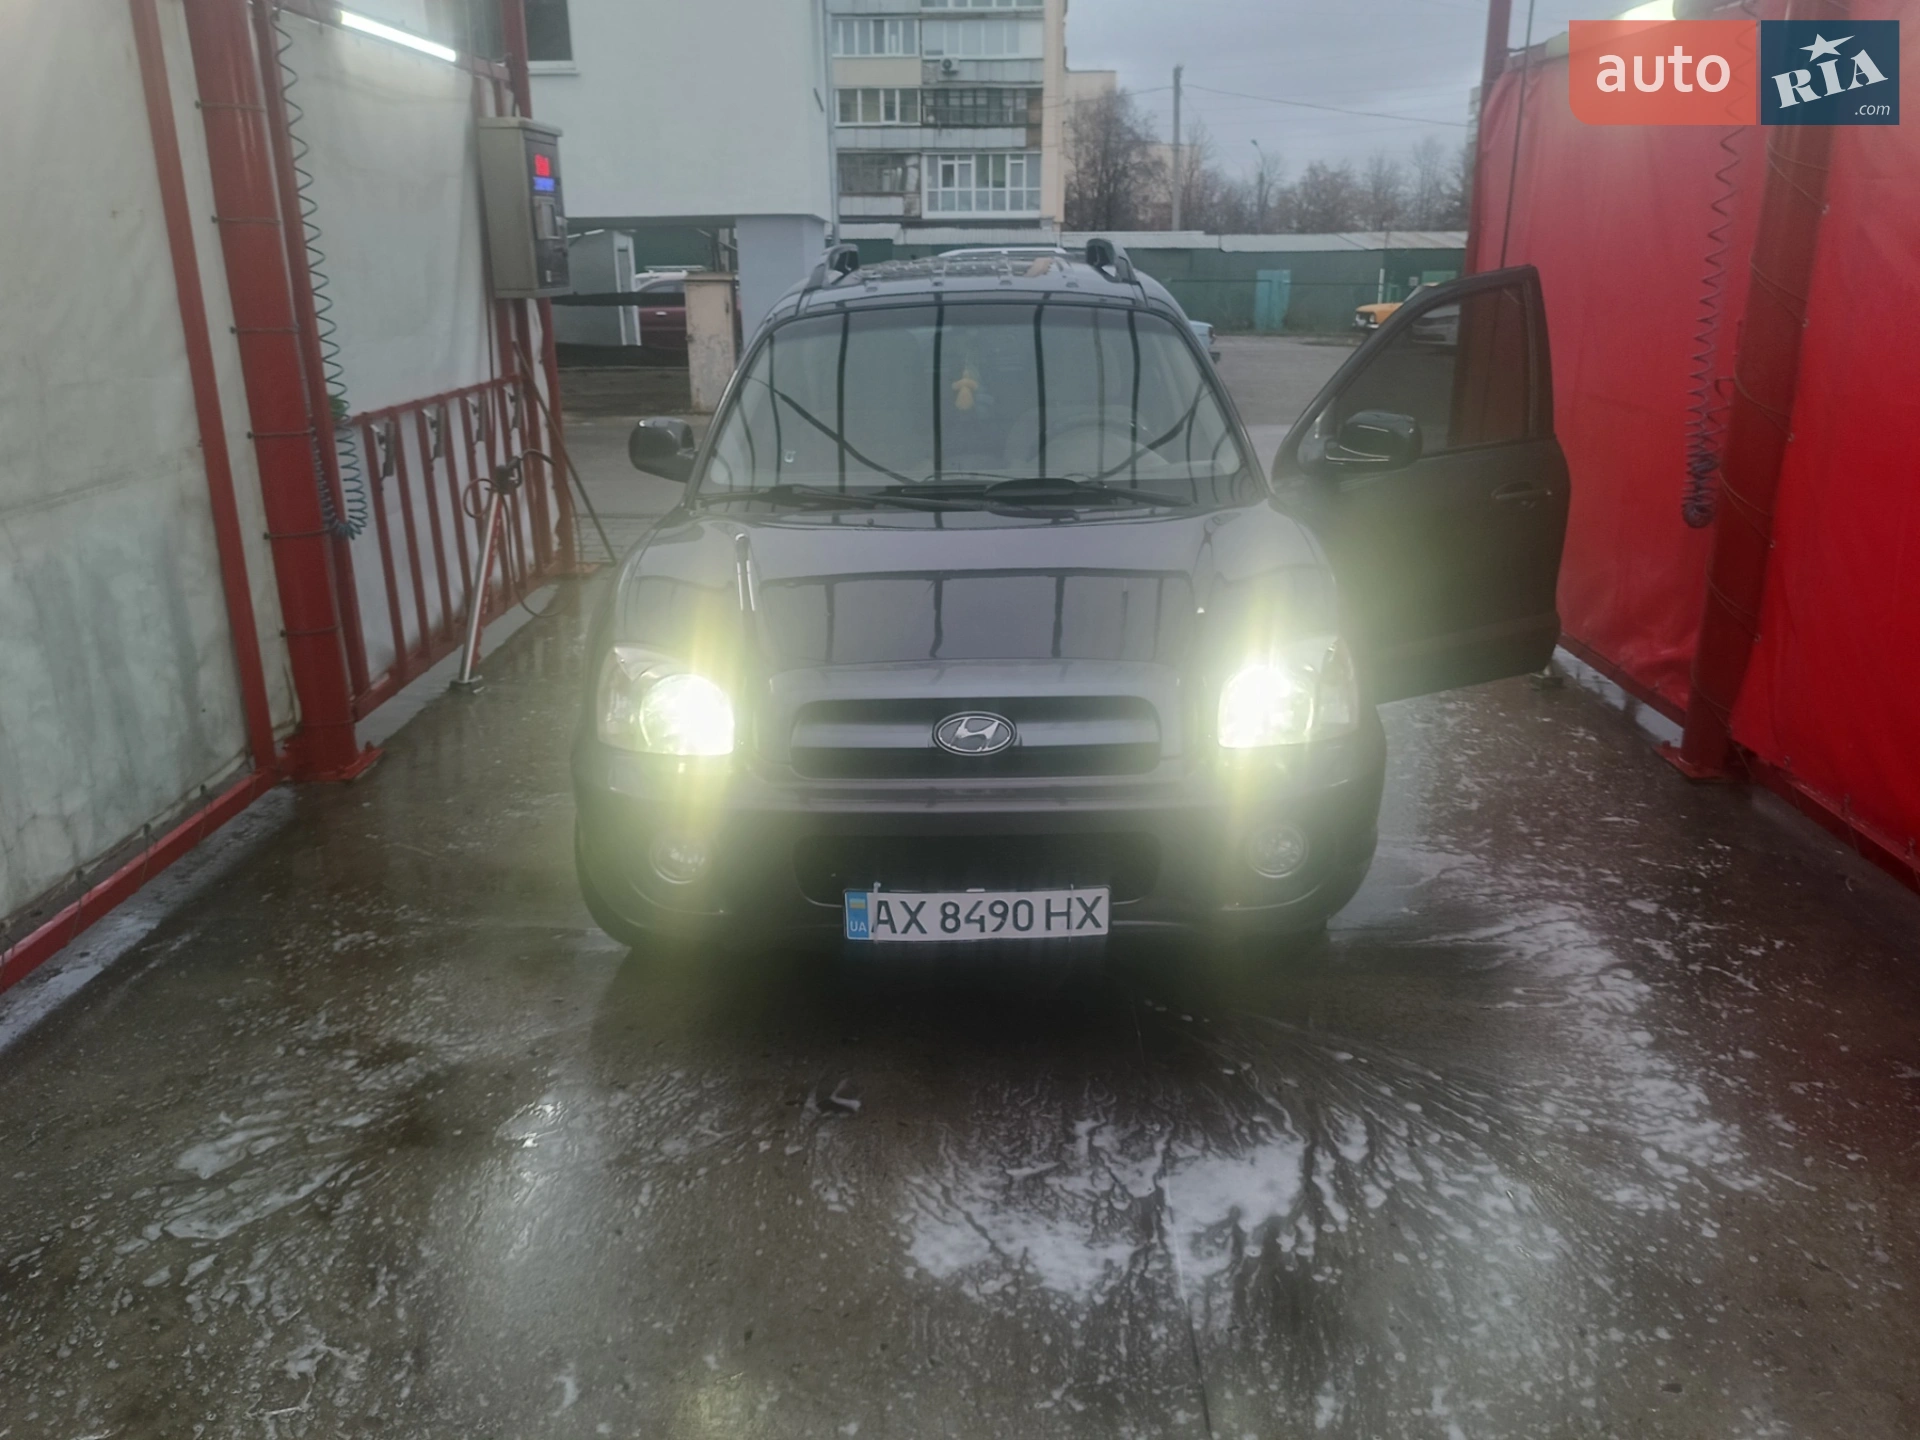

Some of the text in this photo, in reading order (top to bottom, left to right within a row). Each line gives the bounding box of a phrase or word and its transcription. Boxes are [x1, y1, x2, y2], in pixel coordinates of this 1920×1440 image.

[850, 920, 867, 932] UA
[871, 895, 1103, 935] AX 8490 HX
